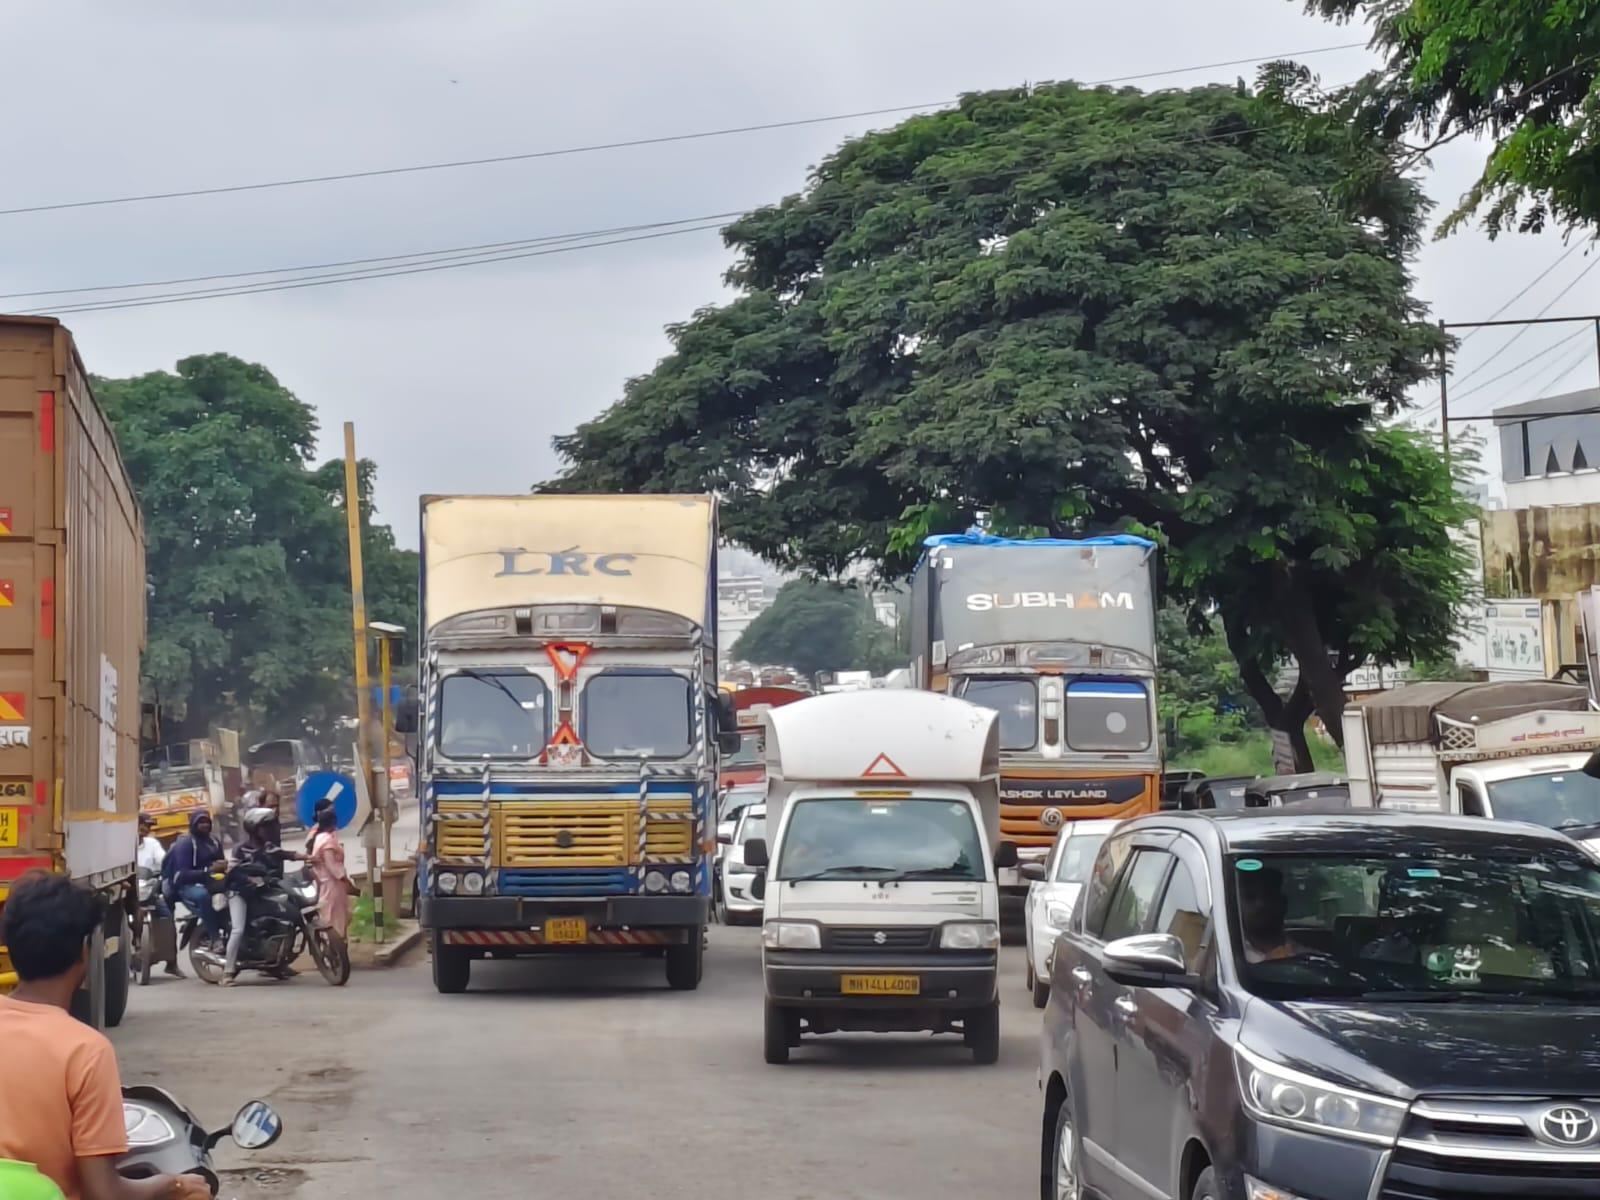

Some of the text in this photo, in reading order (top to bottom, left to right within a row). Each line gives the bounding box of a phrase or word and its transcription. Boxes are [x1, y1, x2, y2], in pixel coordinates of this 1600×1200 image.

[494, 547, 637, 578] LRC
[999, 789, 1107, 799] ASHOK LEYLAND
